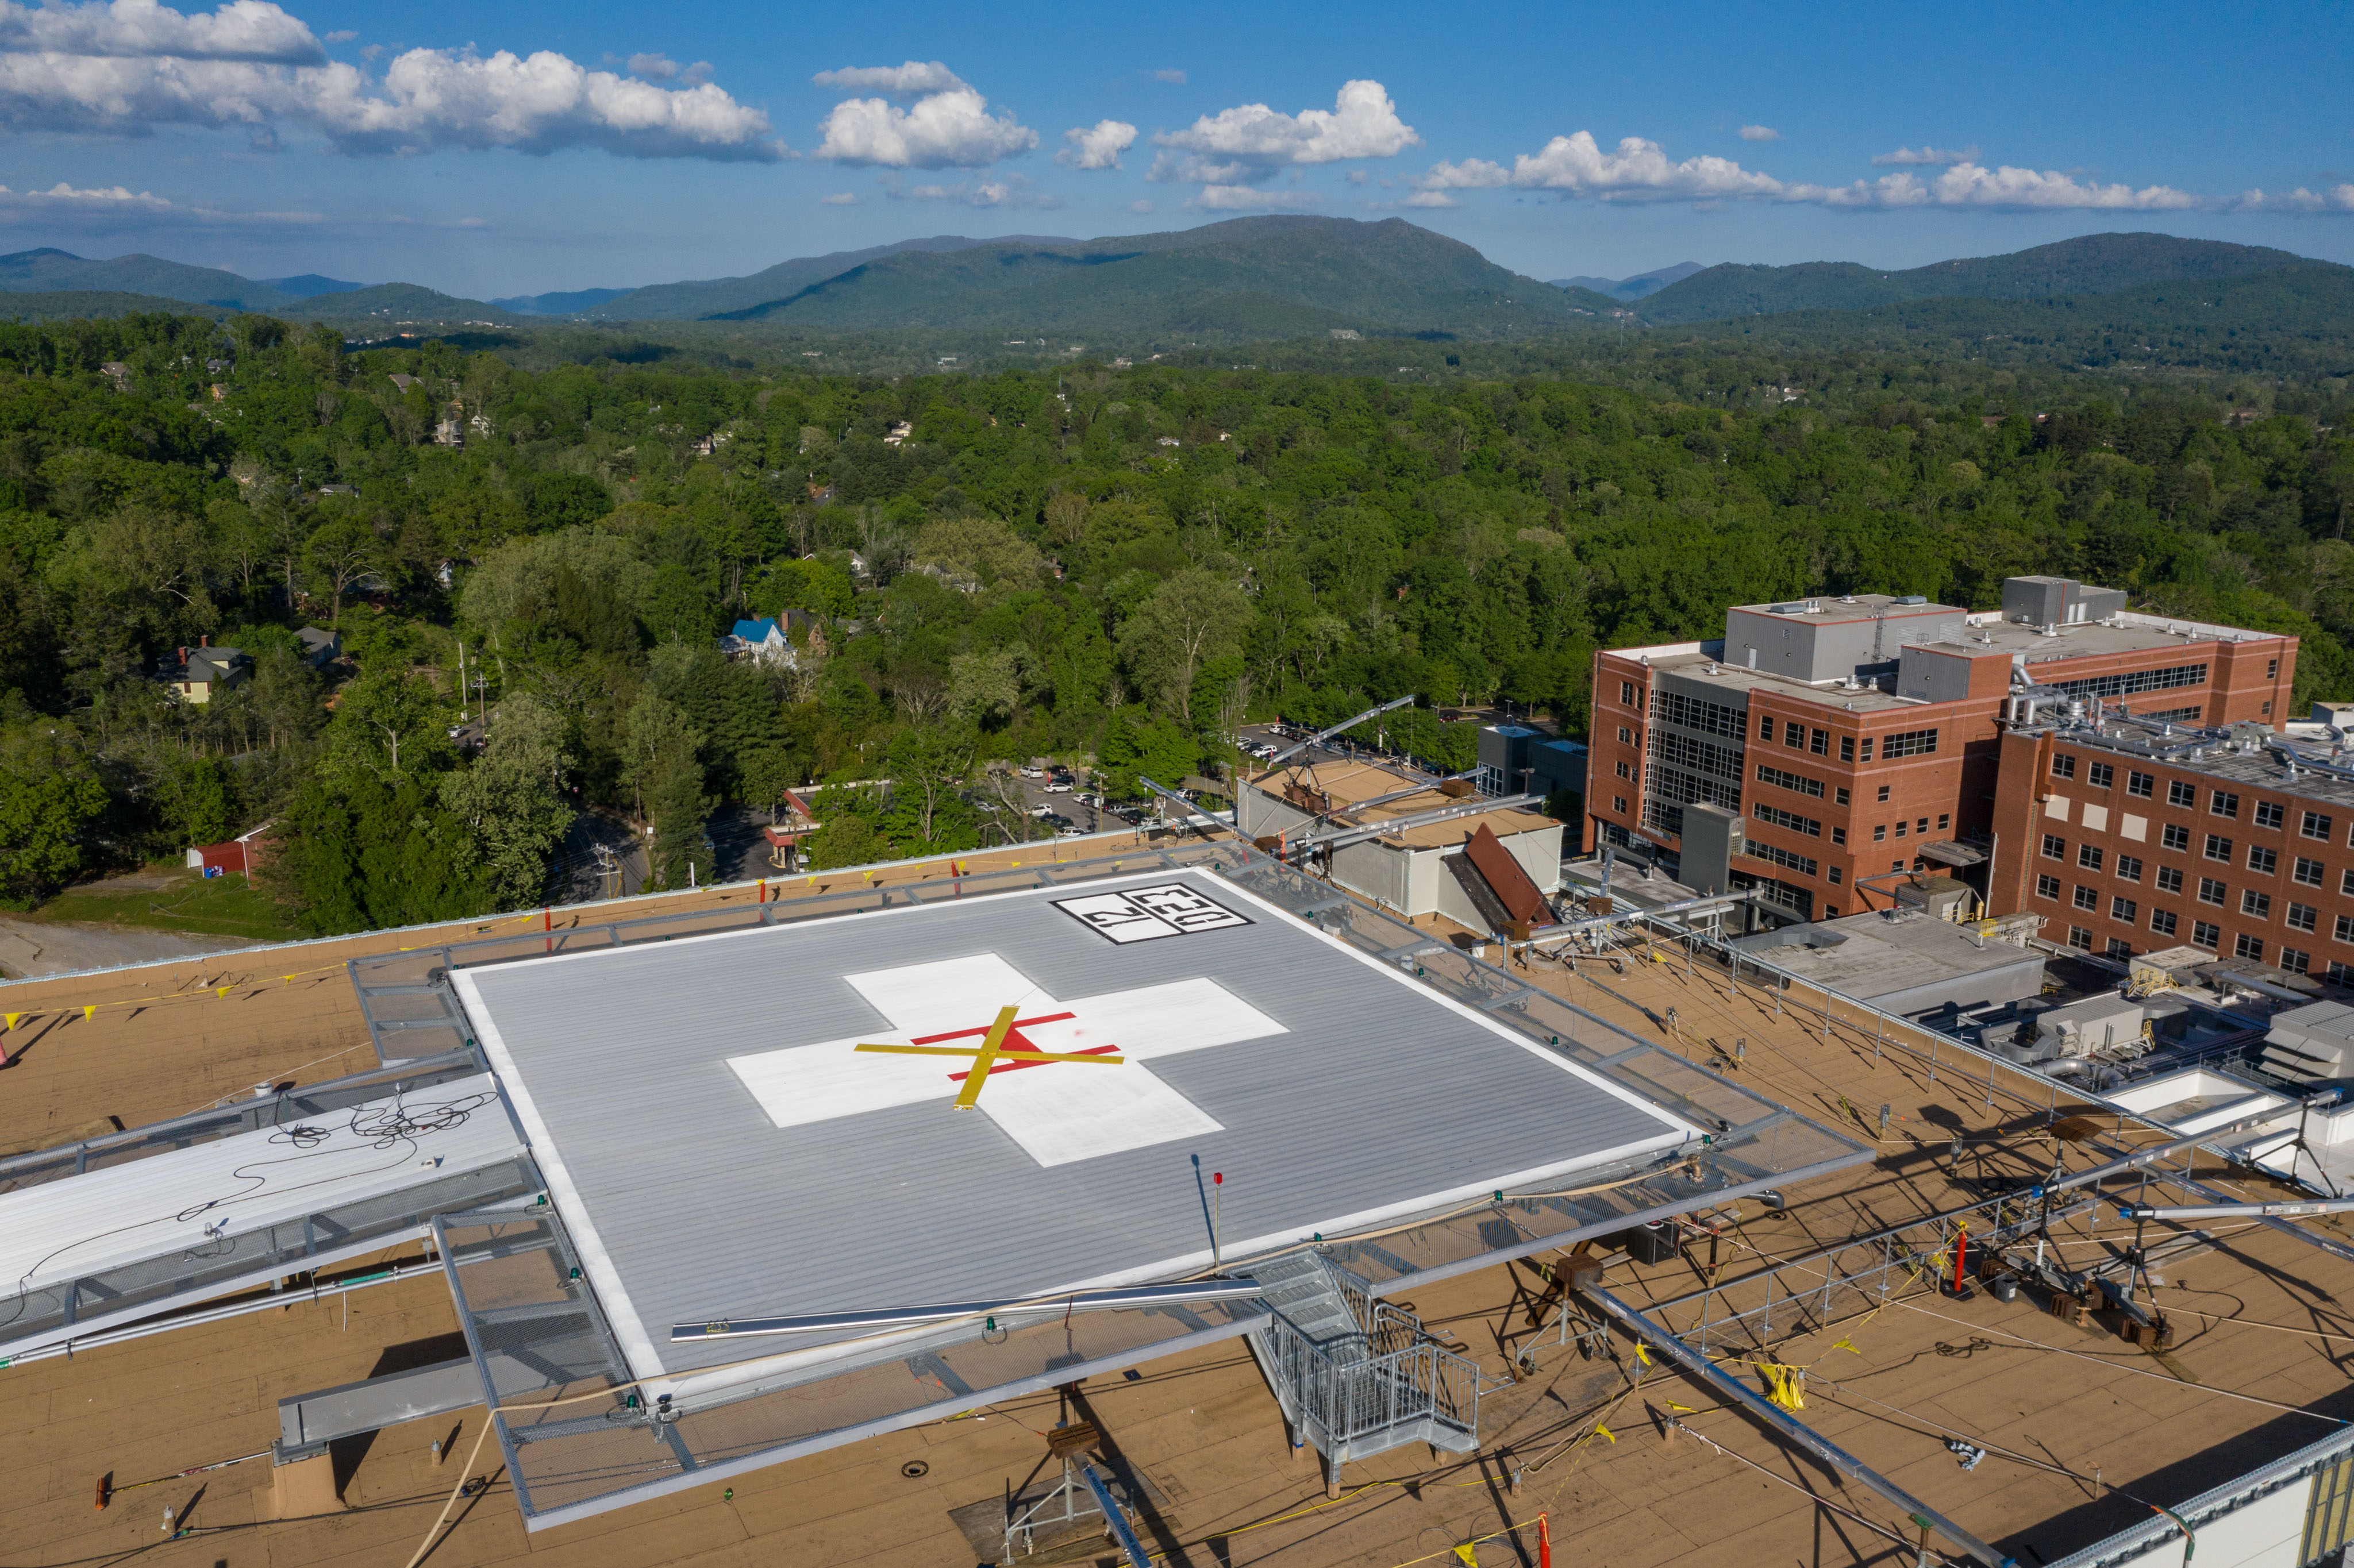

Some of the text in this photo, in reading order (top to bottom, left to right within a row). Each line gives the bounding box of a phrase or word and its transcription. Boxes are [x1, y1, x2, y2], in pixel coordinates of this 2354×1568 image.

[1082, 907, 1152, 927] 12
[910, 1012, 1121, 1081] H
[1120, 1523, 1134, 1543] EASTERN
